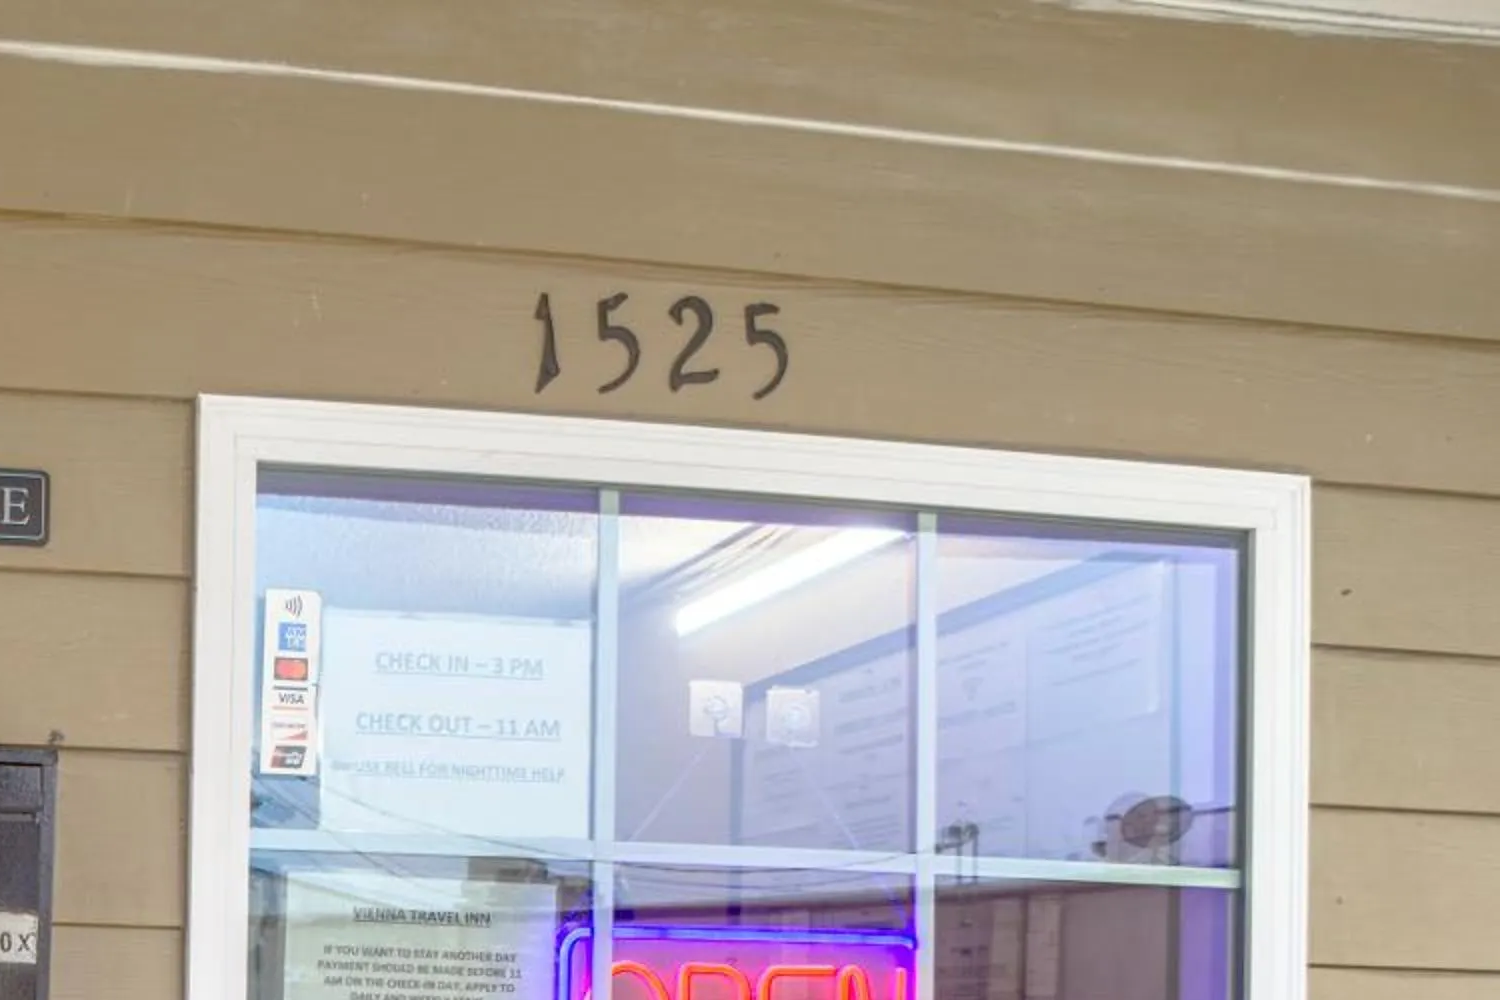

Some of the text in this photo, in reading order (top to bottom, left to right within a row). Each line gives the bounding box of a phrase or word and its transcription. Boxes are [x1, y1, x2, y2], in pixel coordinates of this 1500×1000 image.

[534, 292, 789, 400] 1525
[375, 653, 441, 672] CHECK
[448, 655, 469, 672] IN
[493, 657, 503, 673] 3
[510, 658, 543, 676] PM
[356, 712, 421, 731] CHECK
[428, 714, 473, 733] OUT
[496, 719, 517, 735] 11
[523, 720, 560, 736] AM
[411, 909, 460, 923] TRAVEL
[465, 911, 491, 925] INN
[336, 945, 359, 956] YOU
[362, 946, 393, 957] WANT
[398, 948, 411, 958] TO
[414, 949, 438, 959] STAY
[442, 950, 492, 962] ANOTHER
[495, 952, 516, 963] DAY
[317, 960, 369, 971] PAYMENT
[372, 962, 414, 973] SHOULD
[417, 964, 429, 974] BE
[432, 965, 464, 976] MADE
[324, 976, 342, 985] AM
[346, 977, 362, 987] ON
[365, 977, 383, 988] THE
[465, 981, 497, 992] APPLY
[500, 983, 515, 992] TO
